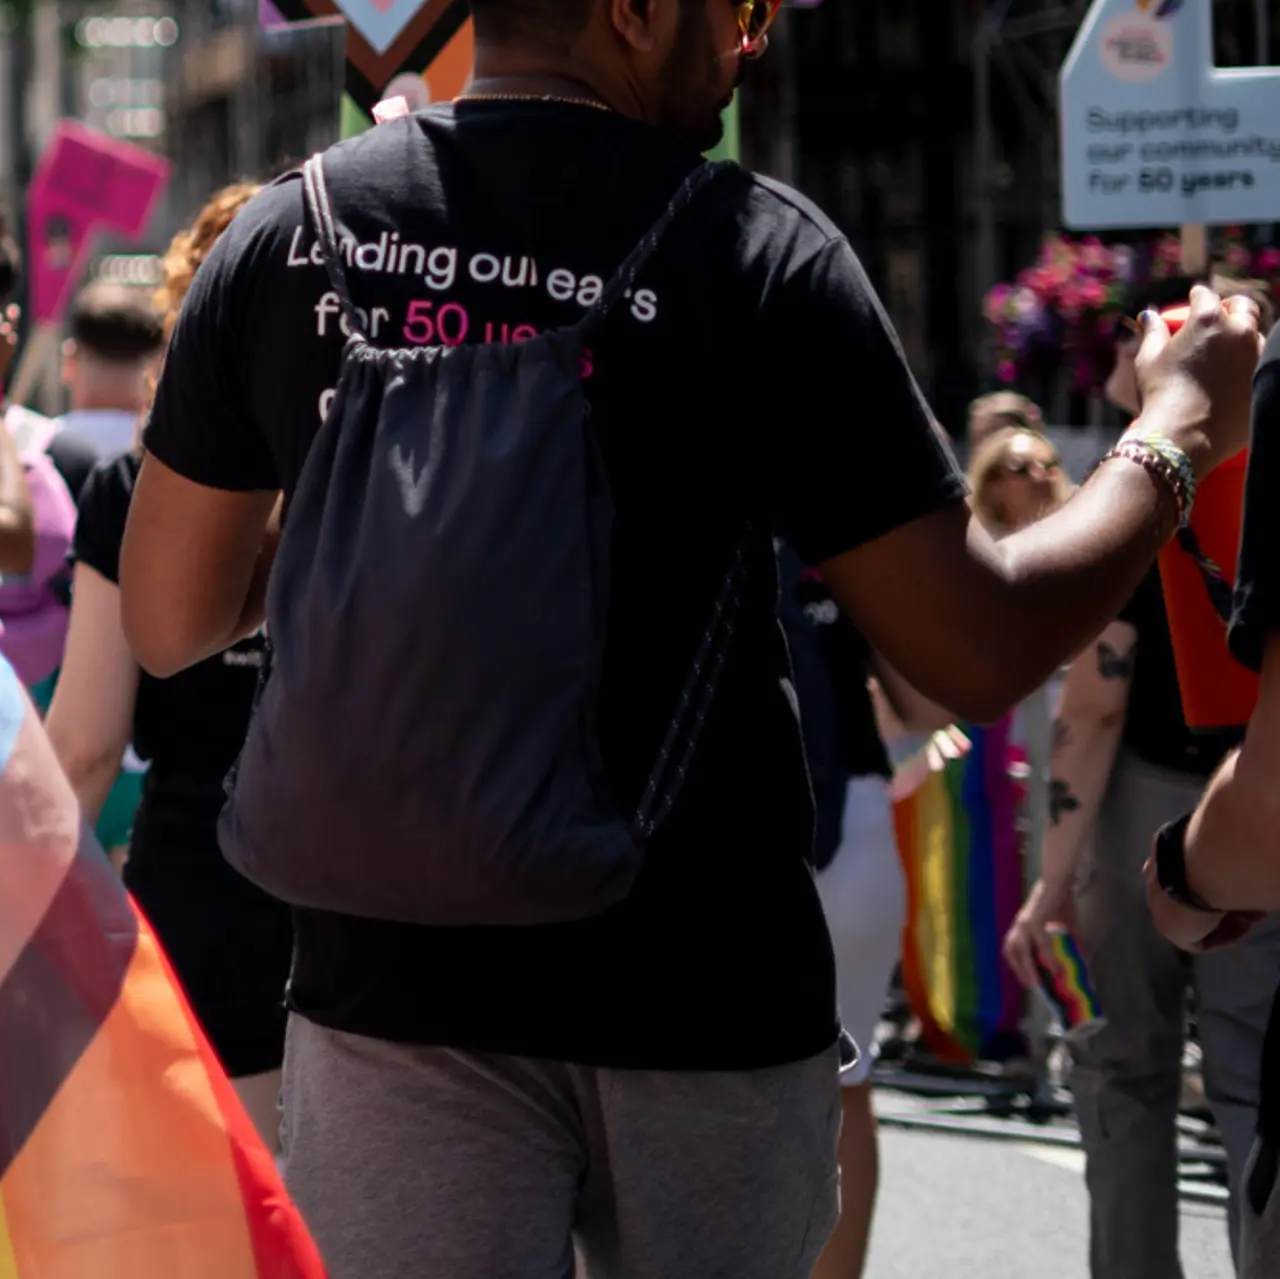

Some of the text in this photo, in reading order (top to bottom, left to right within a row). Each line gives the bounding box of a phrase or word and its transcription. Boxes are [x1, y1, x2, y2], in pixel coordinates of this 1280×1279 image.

[1086, 104, 1239, 137] Supporting
[1138, 166, 1174, 194] 50
[1180, 169, 1256, 200] years
[546, 267, 658, 323] eas
[403, 299, 469, 345] 50
